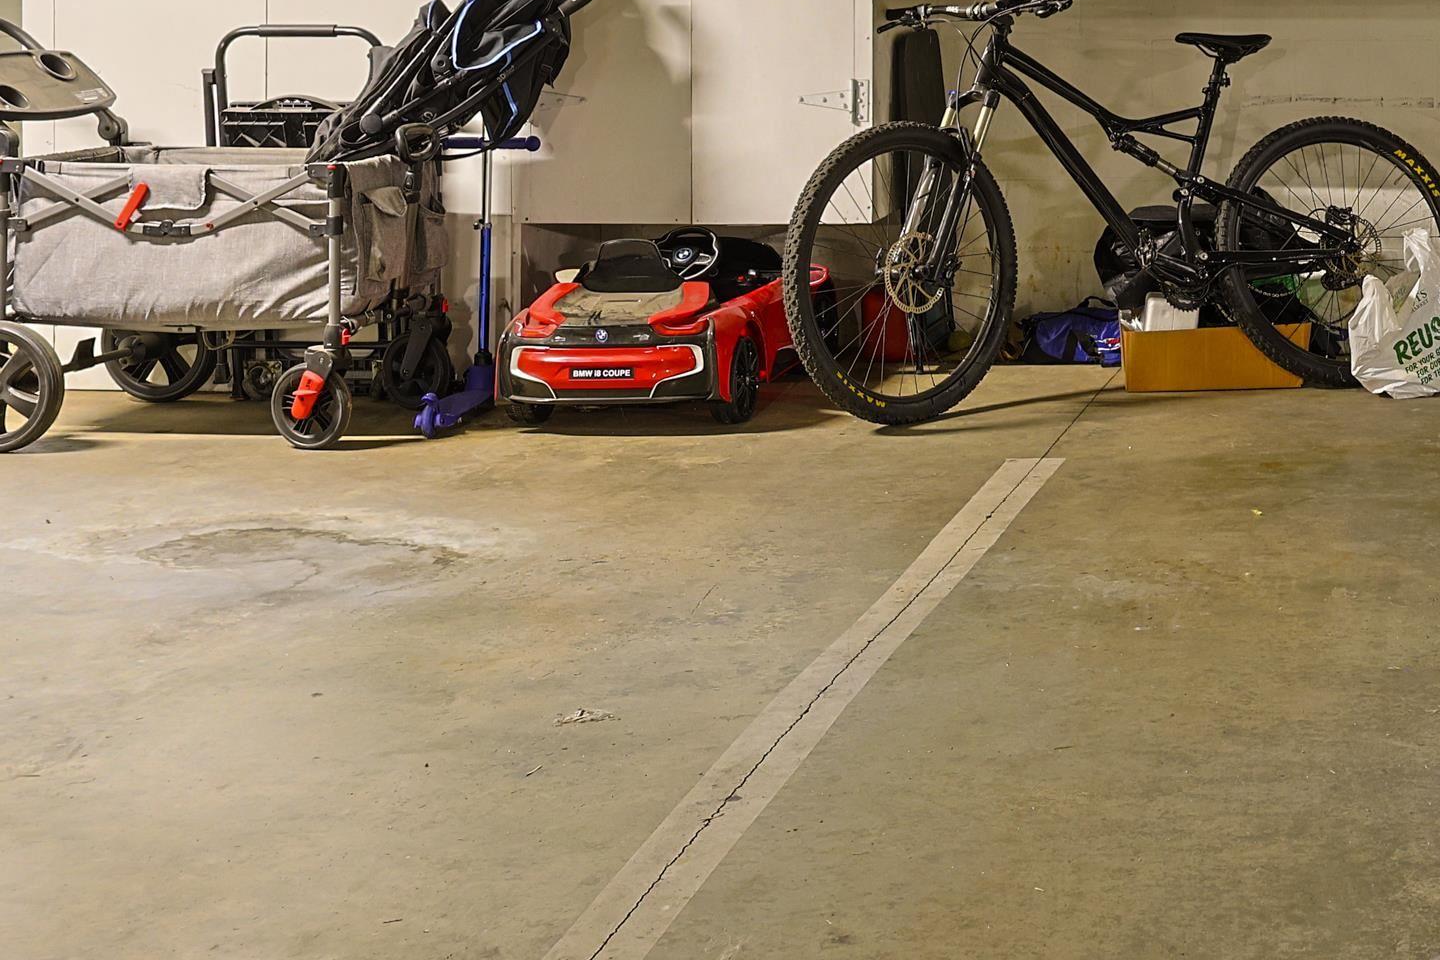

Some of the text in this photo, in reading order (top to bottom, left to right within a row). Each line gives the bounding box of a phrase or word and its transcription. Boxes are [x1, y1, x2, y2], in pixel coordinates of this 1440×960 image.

[1394, 149, 1440, 197] MAXXIS
[1405, 362, 1418, 374] FOR
[1417, 352, 1435, 365] YOUR
[573, 369, 593, 378] BMW
[602, 369, 631, 377] COUPE
[1416, 367, 1428, 378] FOR
[1420, 374, 1433, 385] FOR
